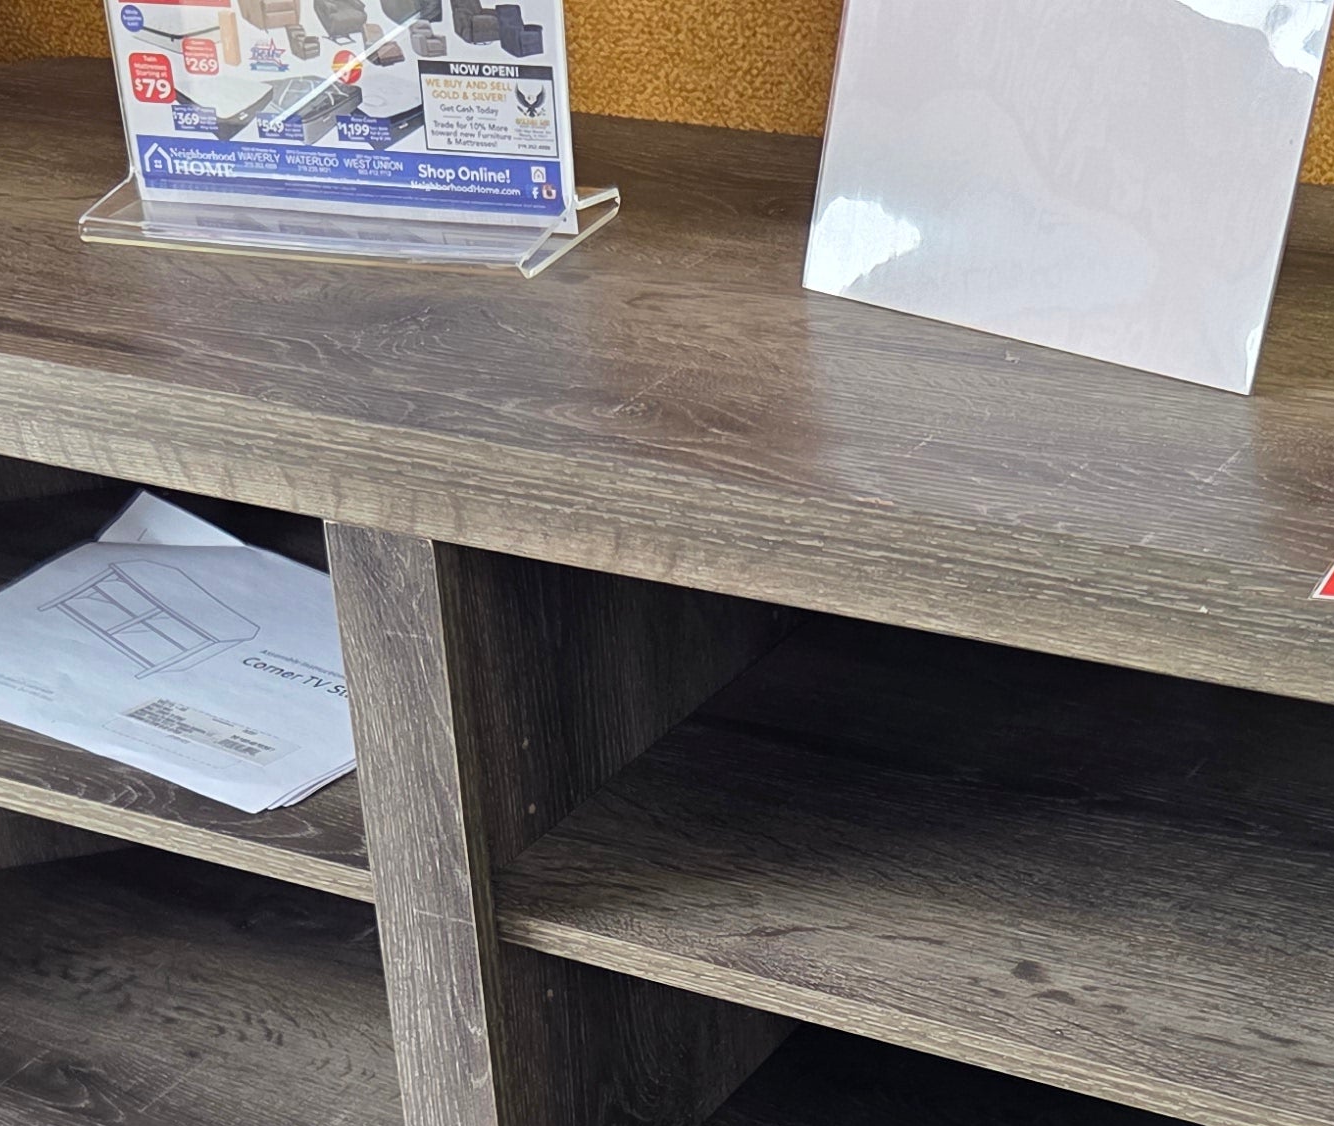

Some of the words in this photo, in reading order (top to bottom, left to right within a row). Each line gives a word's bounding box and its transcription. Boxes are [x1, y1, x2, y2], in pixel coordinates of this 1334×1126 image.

[185, 56, 218, 73] $269
[450, 63, 479, 75] NOW
[482, 65, 519, 78] OPEN!
[135, 78, 172, 99] $79
[425, 79, 441, 88] WE
[443, 79, 462, 88] BUY
[466, 80, 488, 89] AND
[490, 81, 512, 91] SELL
[432, 90, 459, 99] GOLD
[439, 103, 454, 112] Get
[455, 104, 474, 113] Cash
[475, 105, 499, 117] Today
[173, 112, 200, 126] $369
[433, 119, 454, 128] Trade
[456, 121, 467, 129] for
[469, 122, 486, 131] 10%
[488, 123, 508, 132] More
[337, 121, 370, 139] $1,199
[169, 147, 236, 162] Neighborhood
[237, 151, 280, 163] WAVERLY
[285, 154, 340, 168] WATERLOO
[173, 159, 237, 178] HOME
[343, 157, 372, 169] WEST
[373, 160, 404, 172] UNION
[418, 164, 456, 183] Shop
[458, 166, 511, 184] Online!
[410, 180, 521, 196] NeighborhoodHome.com
[242, 657, 304, 680] Corner
[302, 675, 333, 688] TV
